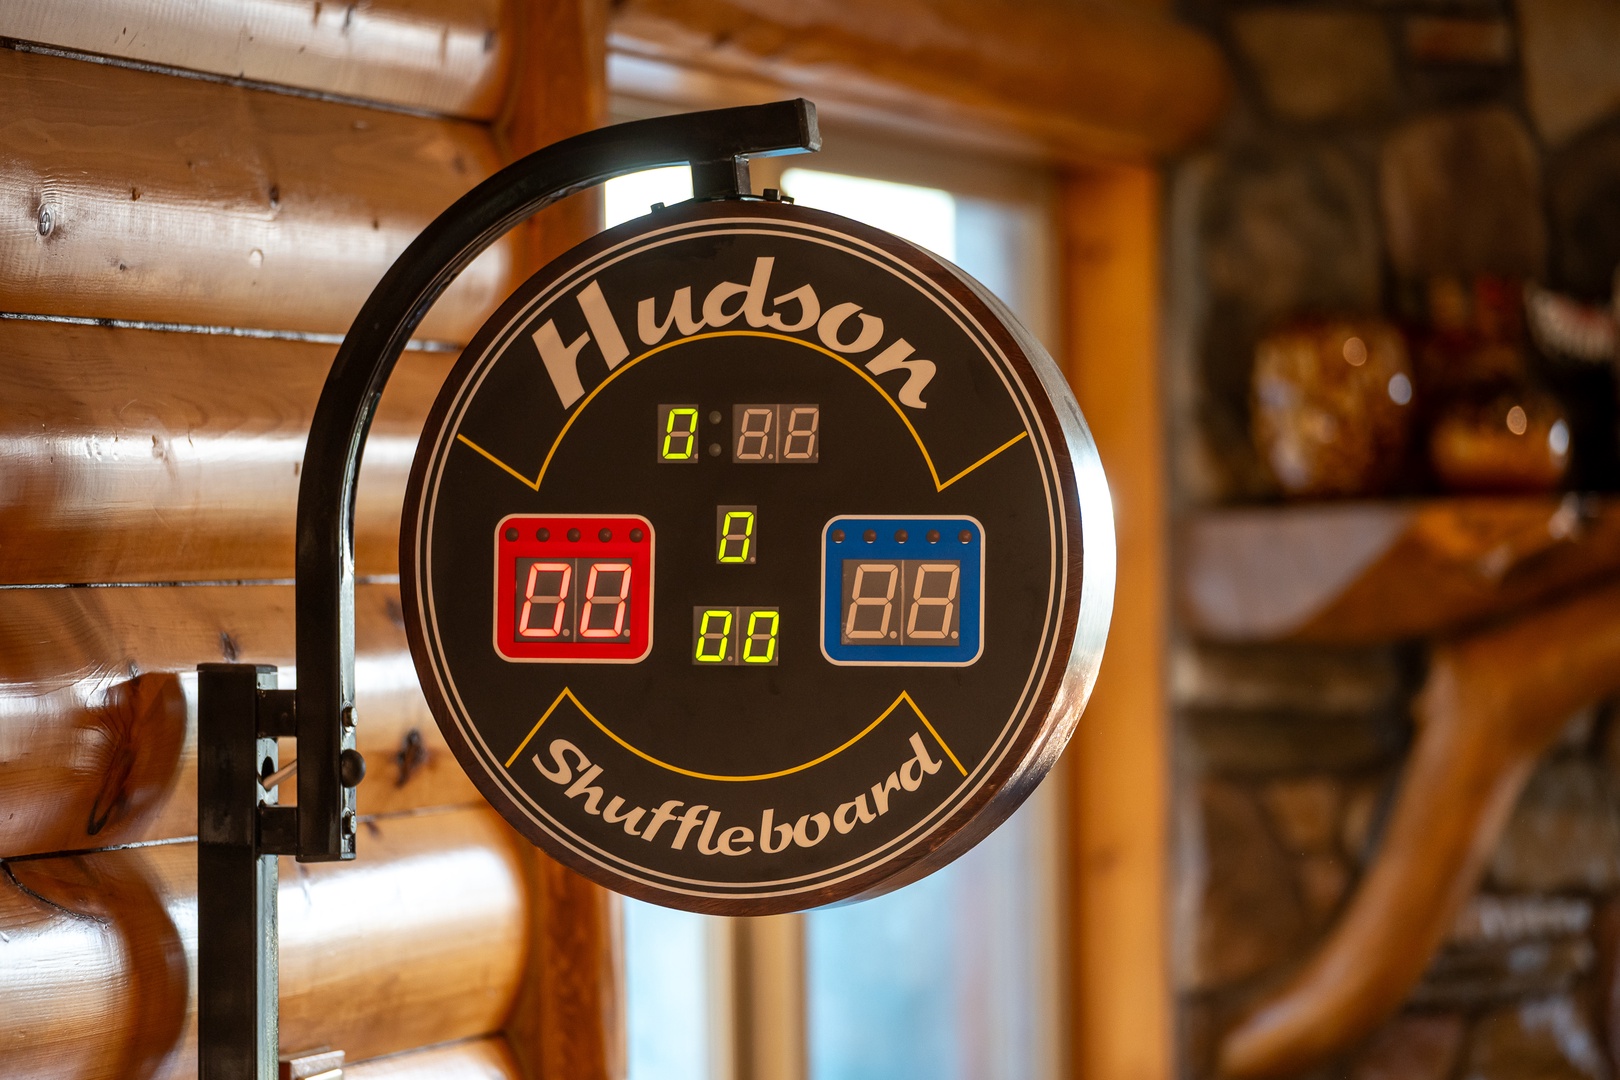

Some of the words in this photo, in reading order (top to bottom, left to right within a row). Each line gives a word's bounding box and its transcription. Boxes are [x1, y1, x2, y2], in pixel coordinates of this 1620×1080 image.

[531, 256, 937, 410] Hudson
[717, 511, 754, 564] 0
[518, 562, 632, 638] 00
[695, 610, 780, 663] 00
[531, 732, 943, 856] Shuffleboard
